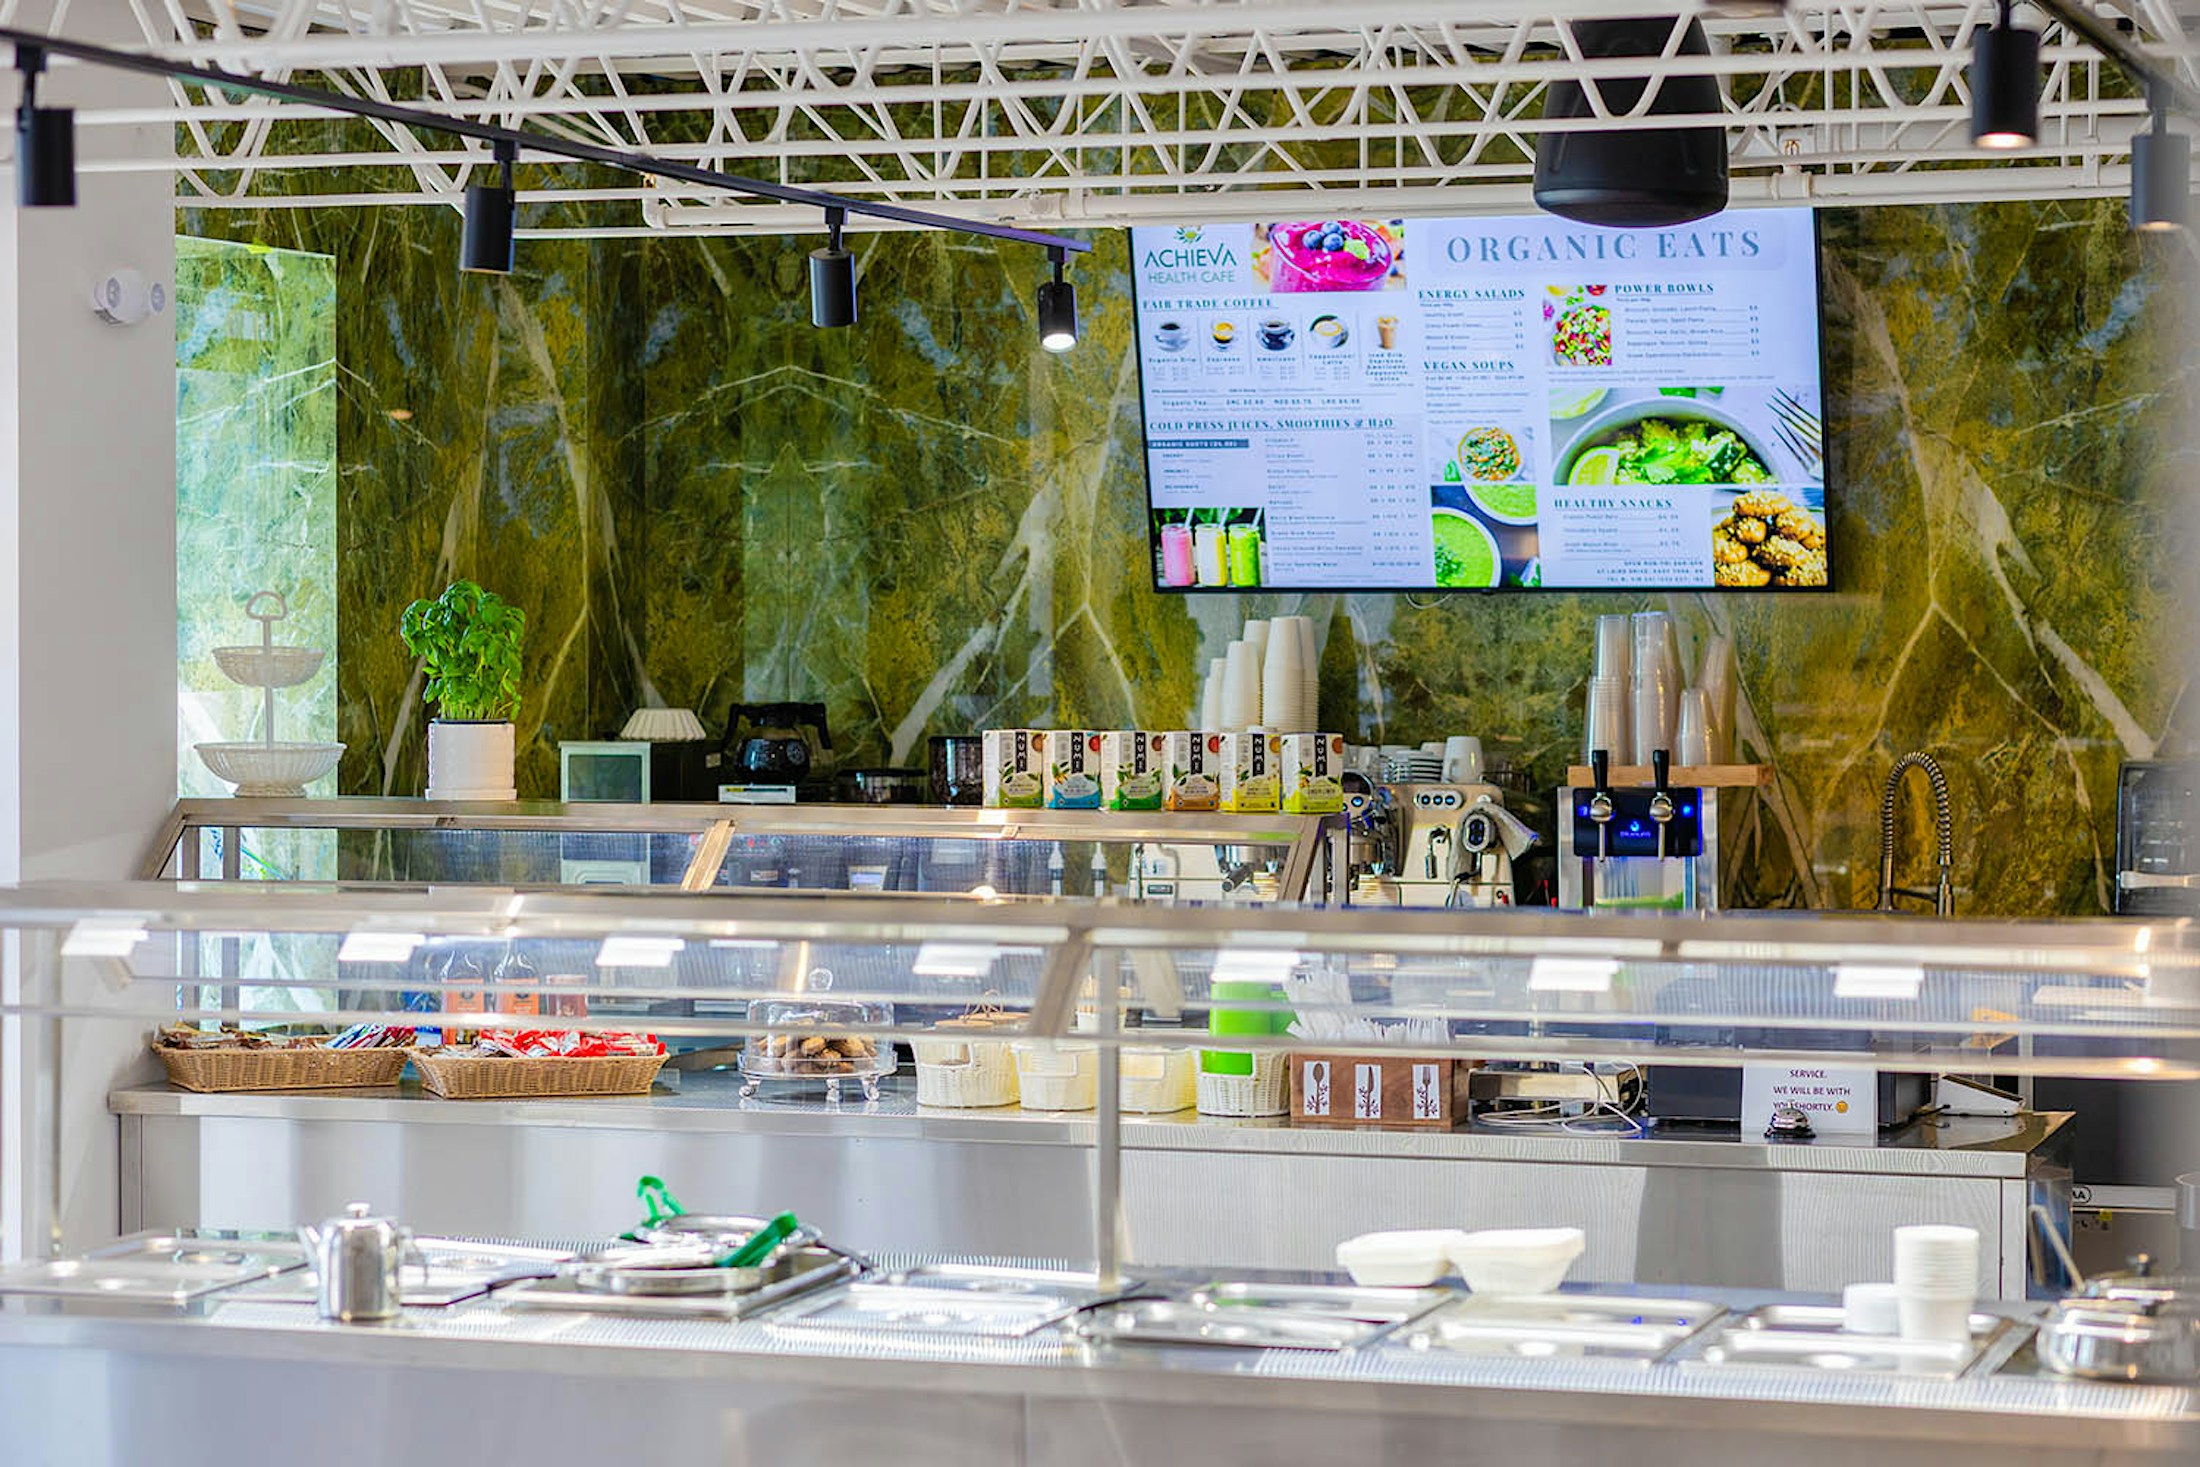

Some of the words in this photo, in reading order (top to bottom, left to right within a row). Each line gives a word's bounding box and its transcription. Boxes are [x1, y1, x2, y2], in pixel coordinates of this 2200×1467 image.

[1447, 233, 1636, 263] ORGANIC
[1658, 230, 1760, 259] EATS
[1144, 242, 1237, 268] ACHIEVA
[1150, 270, 1197, 283] HEALTH
[1200, 269, 1236, 283] CAFE
[1419, 290, 1468, 299] ENERGY
[1474, 288, 1525, 298] SALADS
[1615, 283, 1662, 295] POWER
[1667, 282, 1715, 294] BOWLS
[1143, 299, 1172, 309] FAIR
[1178, 299, 1217, 309] TRADE
[1223, 298, 1271, 308] COFFEE
[1423, 361, 1467, 370] VEGAN
[1472, 360, 1515, 370] SOUPS
[1149, 421, 1183, 431] COLD
[1187, 420, 1224, 430] PRESS
[1277, 418, 1351, 429] SMOOTHIES
[1554, 499, 1614, 509] HEALTHY
[1620, 498, 1673, 508] SNACKS
[1017, 733, 1027, 769] NUMI
[1072, 733, 1083, 770] NUMI
[1136, 733, 1147, 770] NUMI
[1191, 735, 1202, 771] NUMI
[1253, 736, 1264, 771] NUMI
[1316, 738, 1327, 772] NUMI
[1789, 1069, 1828, 1079] SERVICE.
[1773, 1086, 1787, 1095] WE
[1789, 1086, 1811, 1095] WILL
[1813, 1087, 1825, 1095] BE
[1826, 1087, 1851, 1096] WITH
